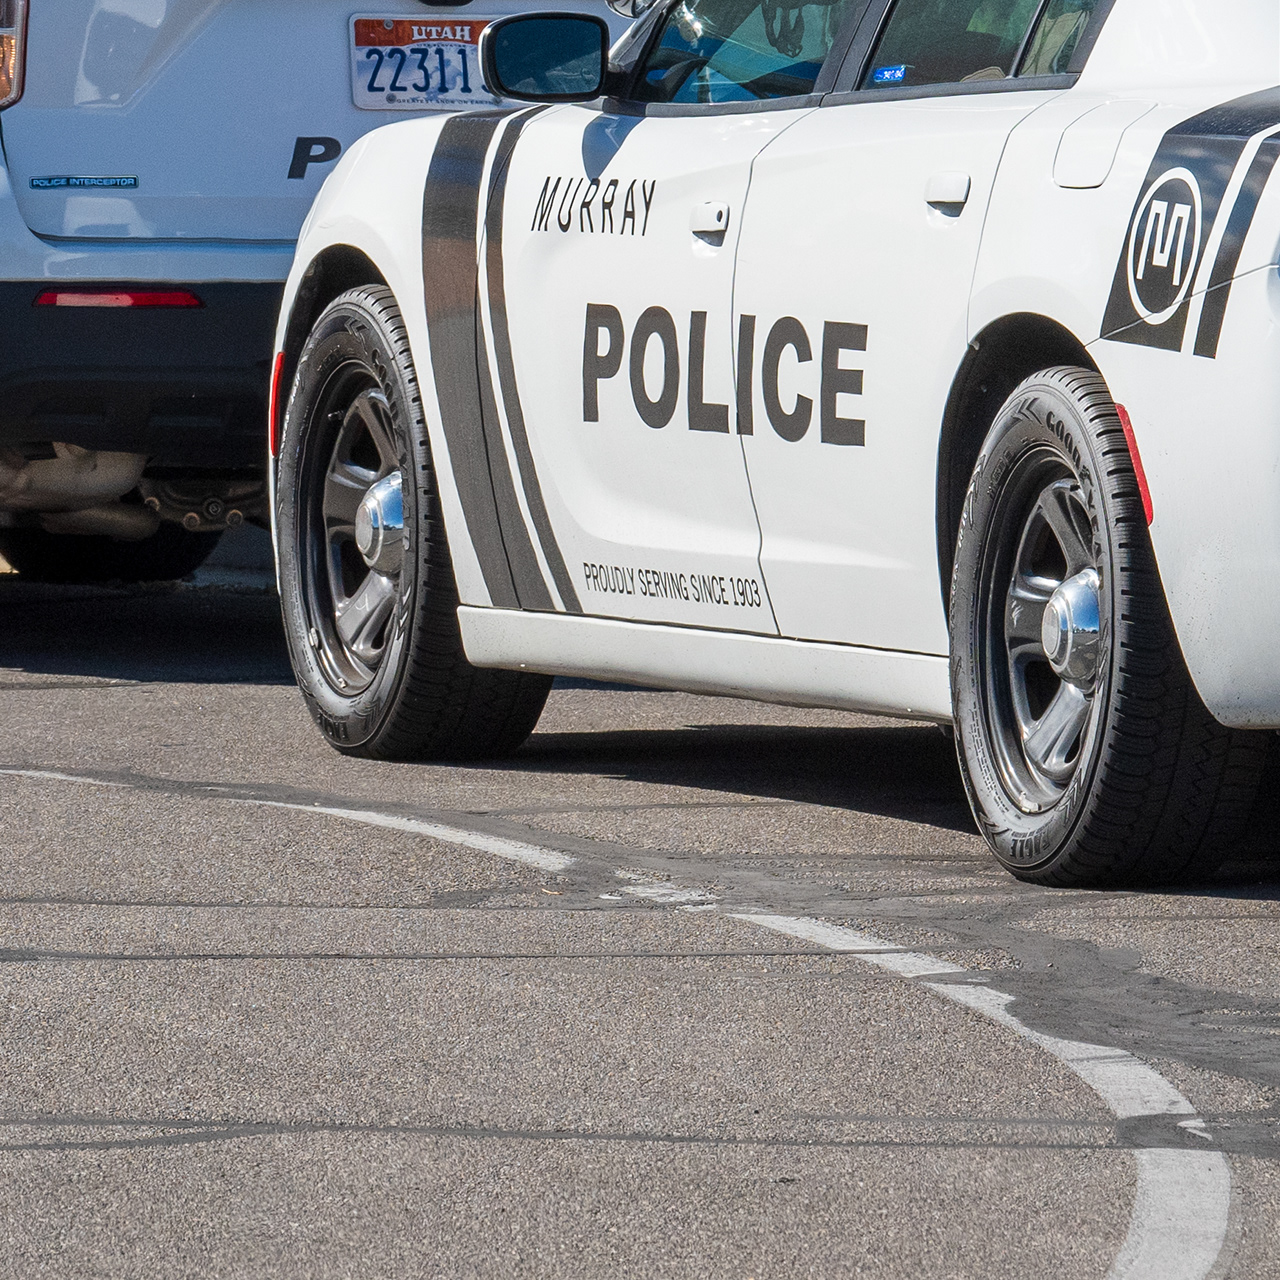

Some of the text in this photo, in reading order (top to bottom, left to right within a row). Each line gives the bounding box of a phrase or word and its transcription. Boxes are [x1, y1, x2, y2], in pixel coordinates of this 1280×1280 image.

[411, 25, 472, 41] UTAH
[365, 47, 491, 94] 22311
[33, 178, 135, 187] POLICE INTERCEPTOR
[530, 176, 657, 236] MURRAY
[582, 302, 869, 447] POLICE
[583, 561, 762, 608] PROUDLY SERVING SINCE 1903
